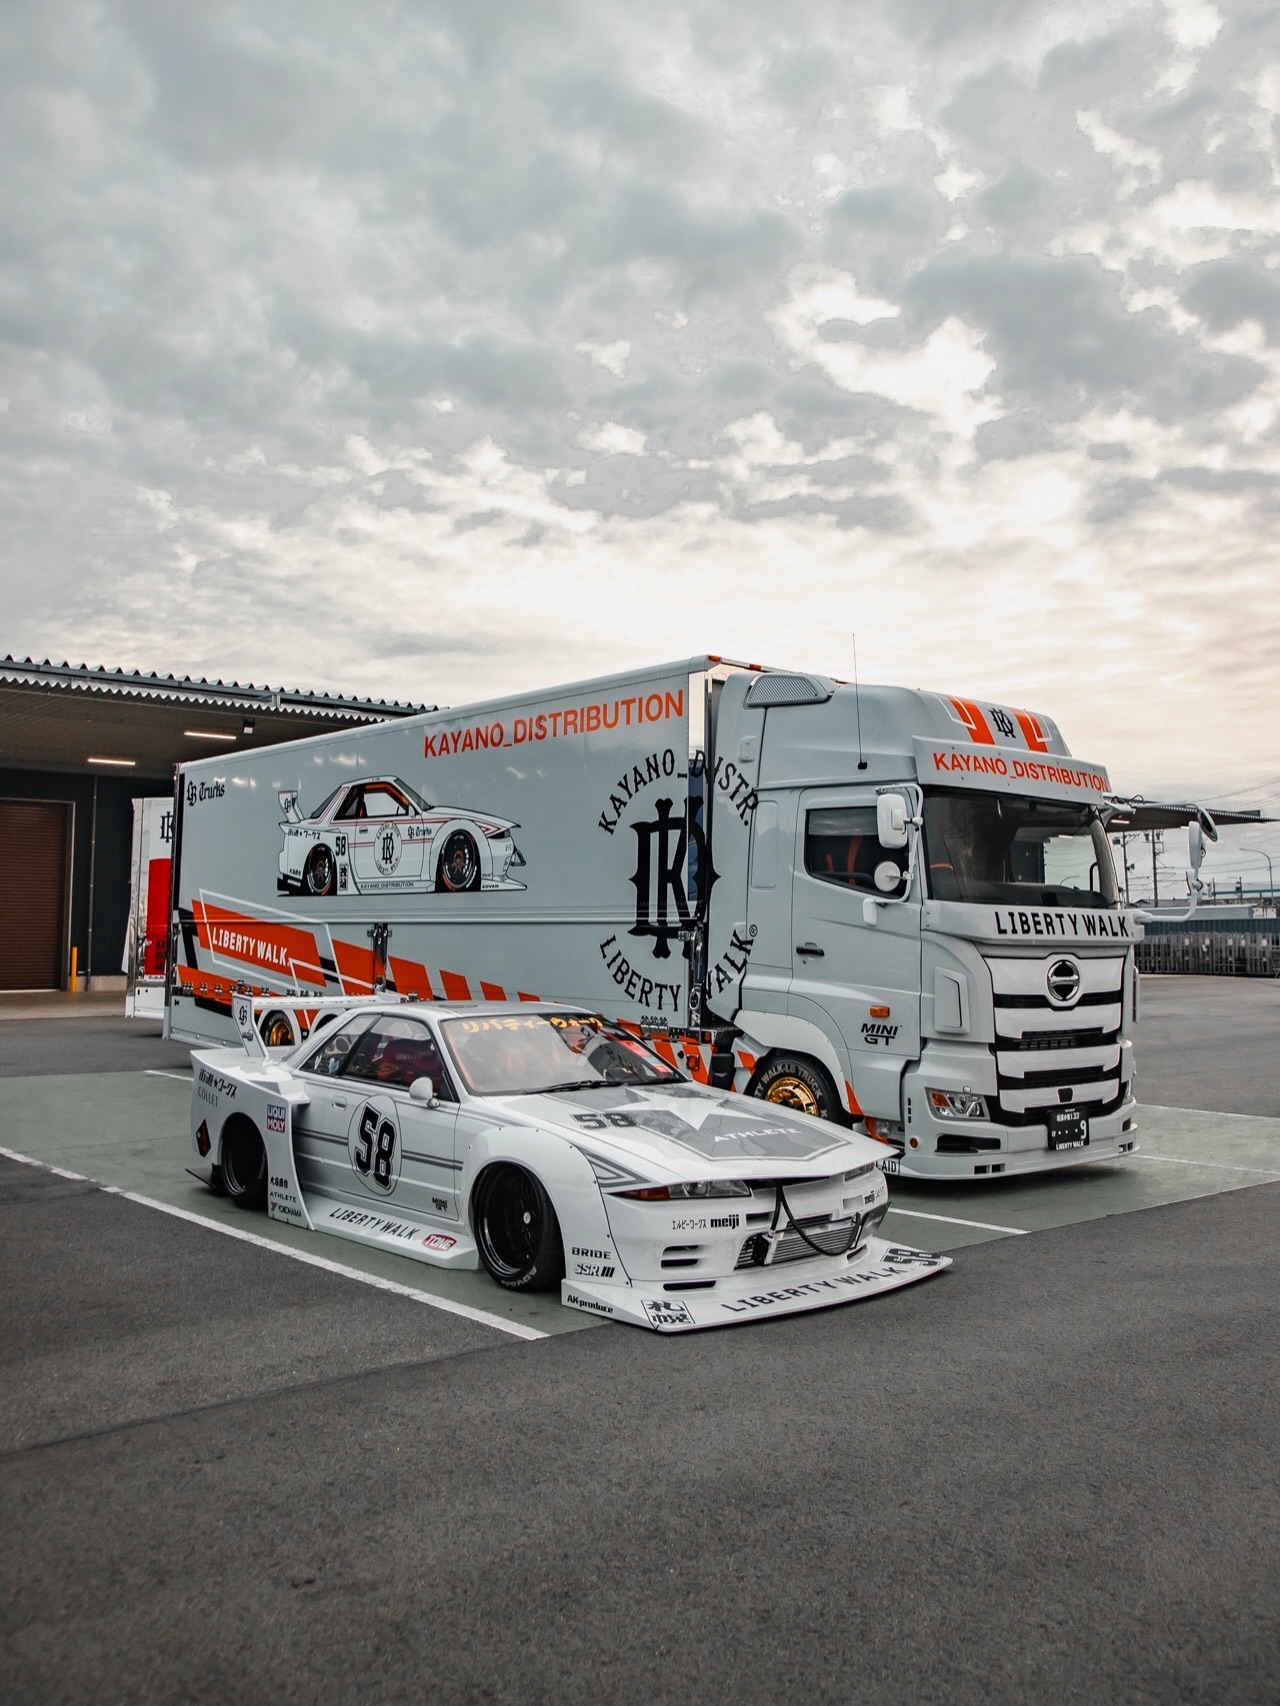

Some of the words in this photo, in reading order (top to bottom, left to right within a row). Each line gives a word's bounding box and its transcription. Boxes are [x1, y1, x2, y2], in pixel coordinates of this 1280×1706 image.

[424, 689, 684, 758] KAYANO_DISTRIBUTION
[933, 753, 1108, 792] KAYANO_DISTRIBUTION
[199, 780, 226, 802] Trucks
[335, 836, 347, 856] 58
[995, 911, 1078, 935] LIBERTY
[1082, 914, 1129, 937] WALK
[212, 927, 256, 956] LIBERTY
[600, 934, 681, 1012] LIBERTY
[861, 1023, 899, 1036] MINI
[864, 1034, 896, 1046] GT
[197, 1086, 219, 1107] COLLET
[268, 1105, 286, 1120] LIQUI
[570, 1113, 640, 1129] 58
[267, 1118, 286, 1133] MOLY
[714, 1127, 802, 1143] ATHLETE
[355, 1102, 397, 1190] 58
[270, 1191, 297, 1203] ATHLETE
[329, 1207, 385, 1229] LIBERTY
[380, 1221, 420, 1240] WALK
[711, 1214, 739, 1230] meiji
[425, 1235, 455, 1250] TONE
[572, 1246, 611, 1259] BRIDE
[721, 1280, 838, 1312] LIBERTY
[836, 1266, 908, 1286] WALK
